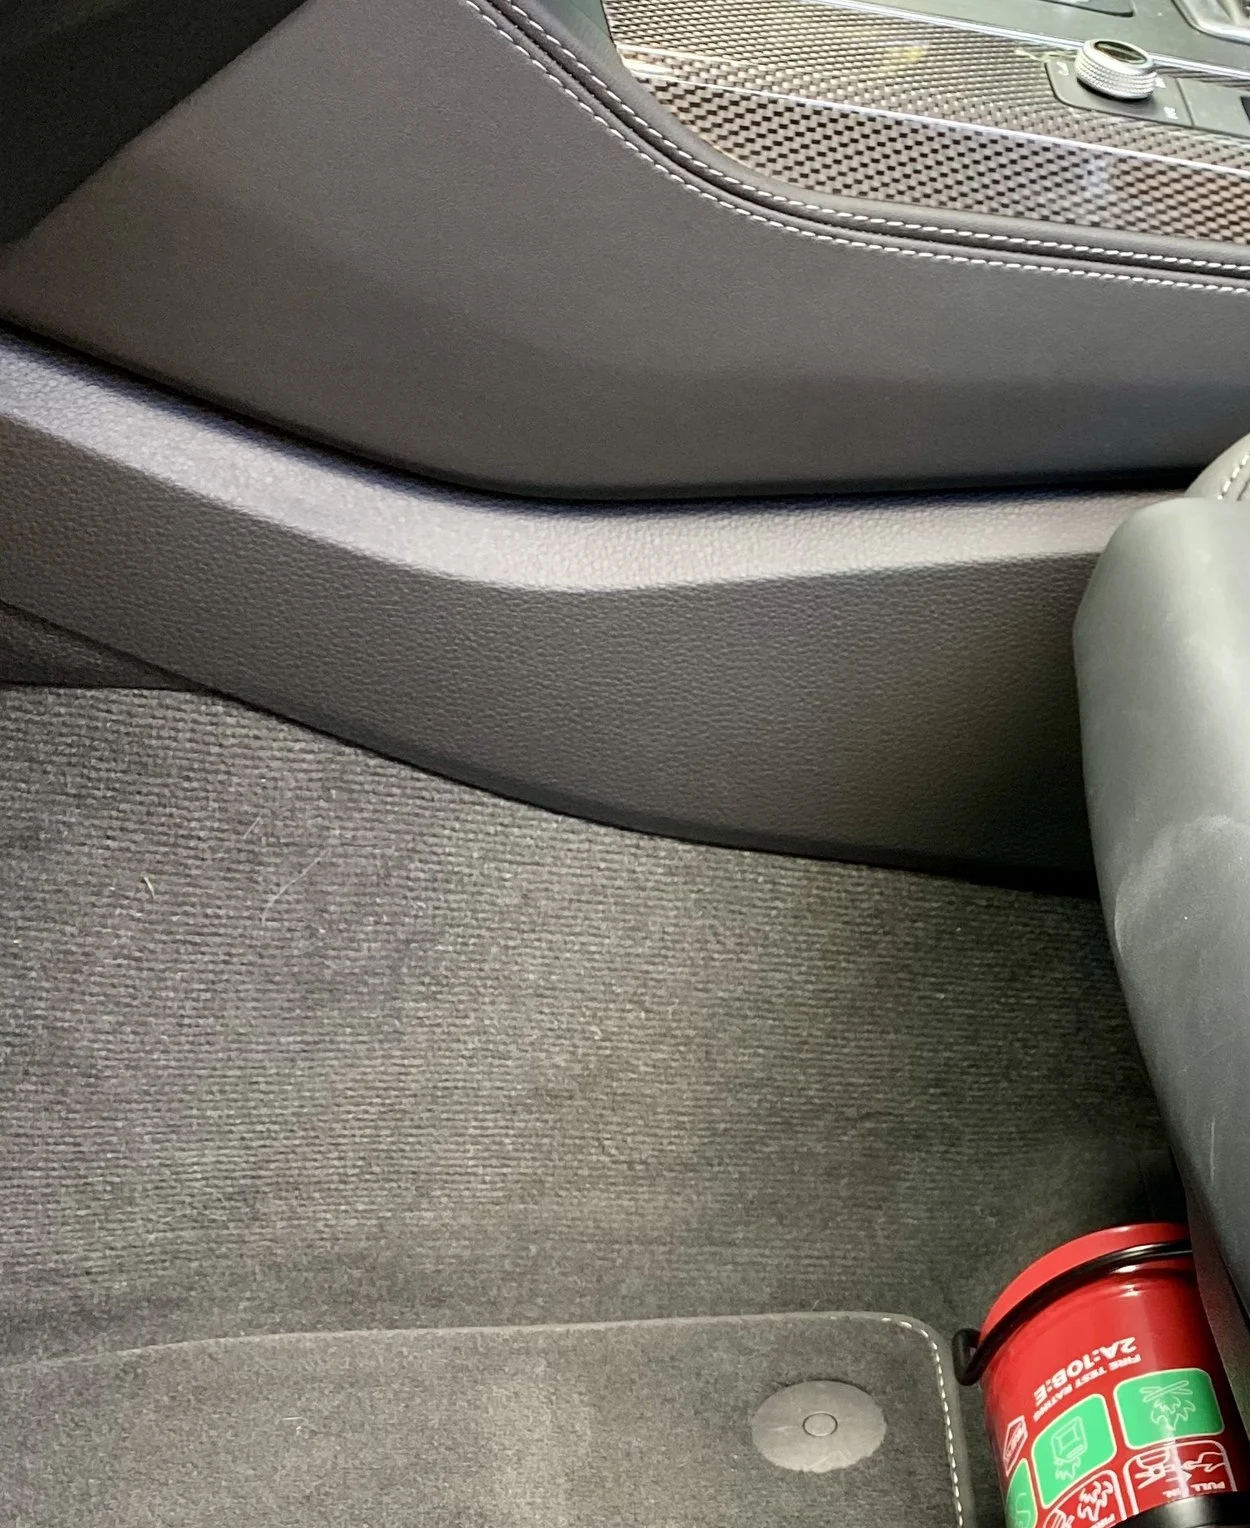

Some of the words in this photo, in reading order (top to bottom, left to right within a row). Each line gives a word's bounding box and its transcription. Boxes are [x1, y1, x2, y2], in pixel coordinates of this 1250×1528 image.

[1033, 1336, 1137, 1406] 2A:10B:E
[1110, 1354, 1142, 1372] FIRE
[1076, 1366, 1108, 1388] TEST
[1033, 1383, 1074, 1422] RATING
[1191, 1479, 1225, 1491] PULL
